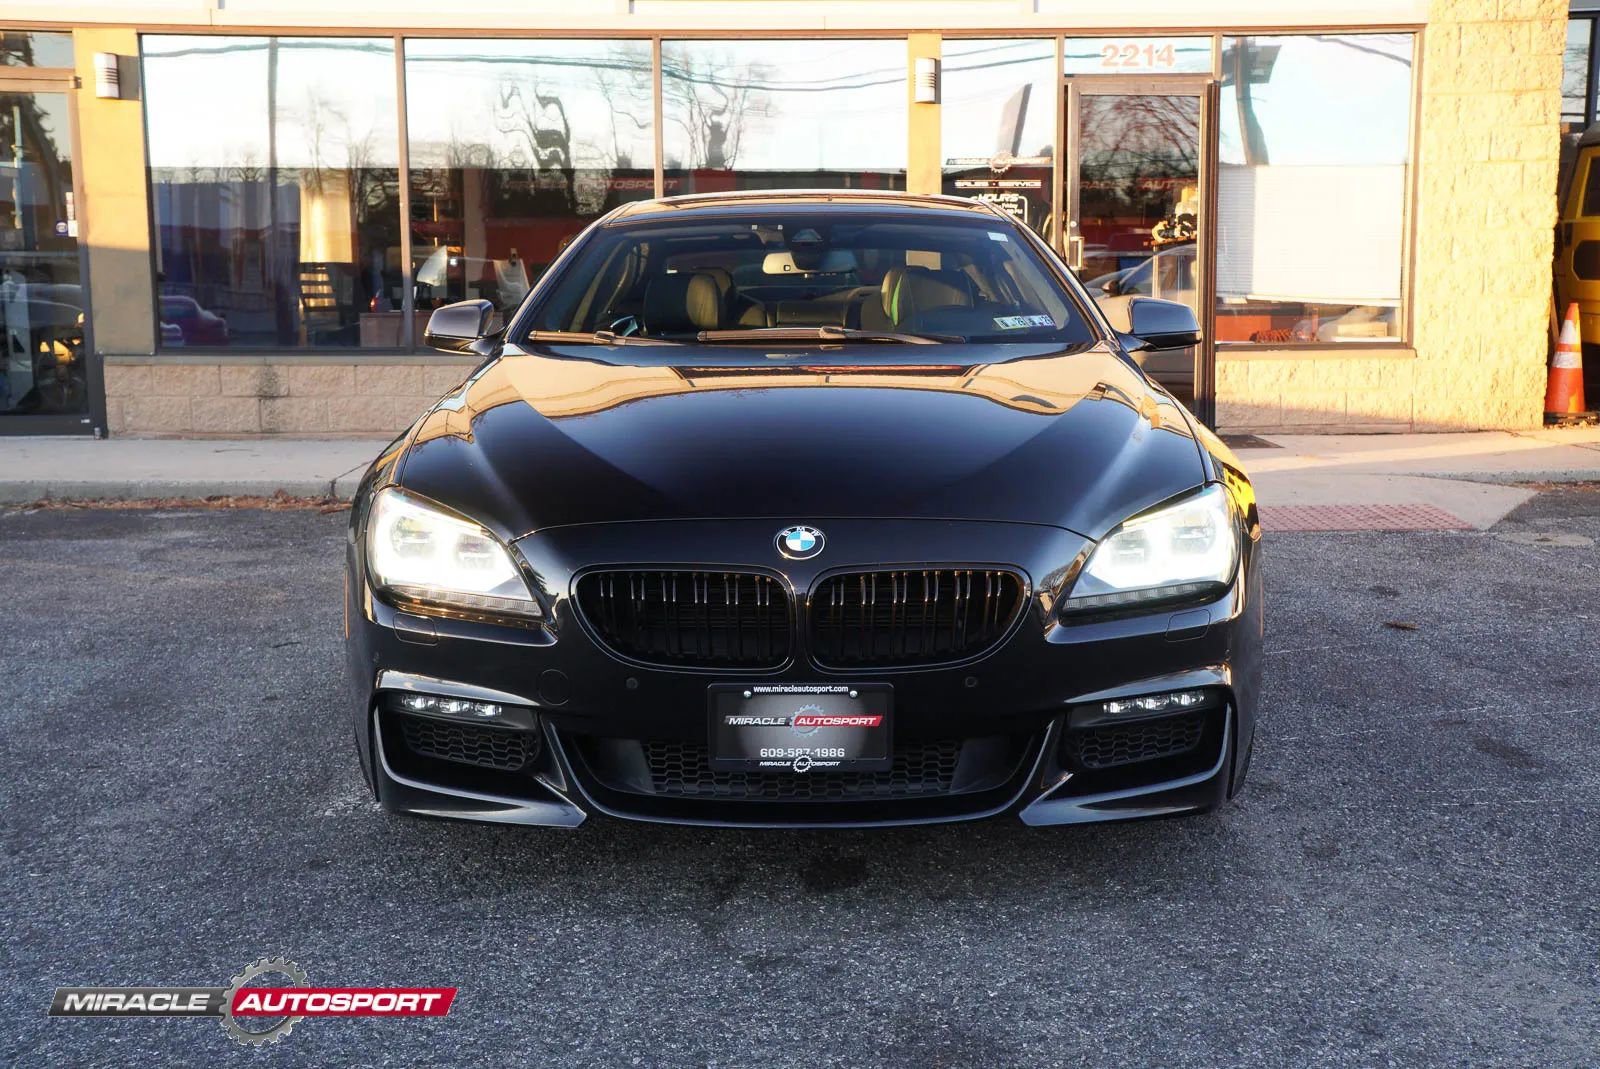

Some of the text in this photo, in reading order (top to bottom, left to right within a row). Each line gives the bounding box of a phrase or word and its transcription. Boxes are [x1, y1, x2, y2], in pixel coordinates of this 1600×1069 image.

[1101, 43, 1176, 67] 2214
[978, 193, 1020, 203] HOURS
[753, 685, 849, 694] www.miracleautosport.com
[728, 716, 877, 726] MIRACLE AUTOSPORT
[760, 748, 845, 758] 609-587-1986
